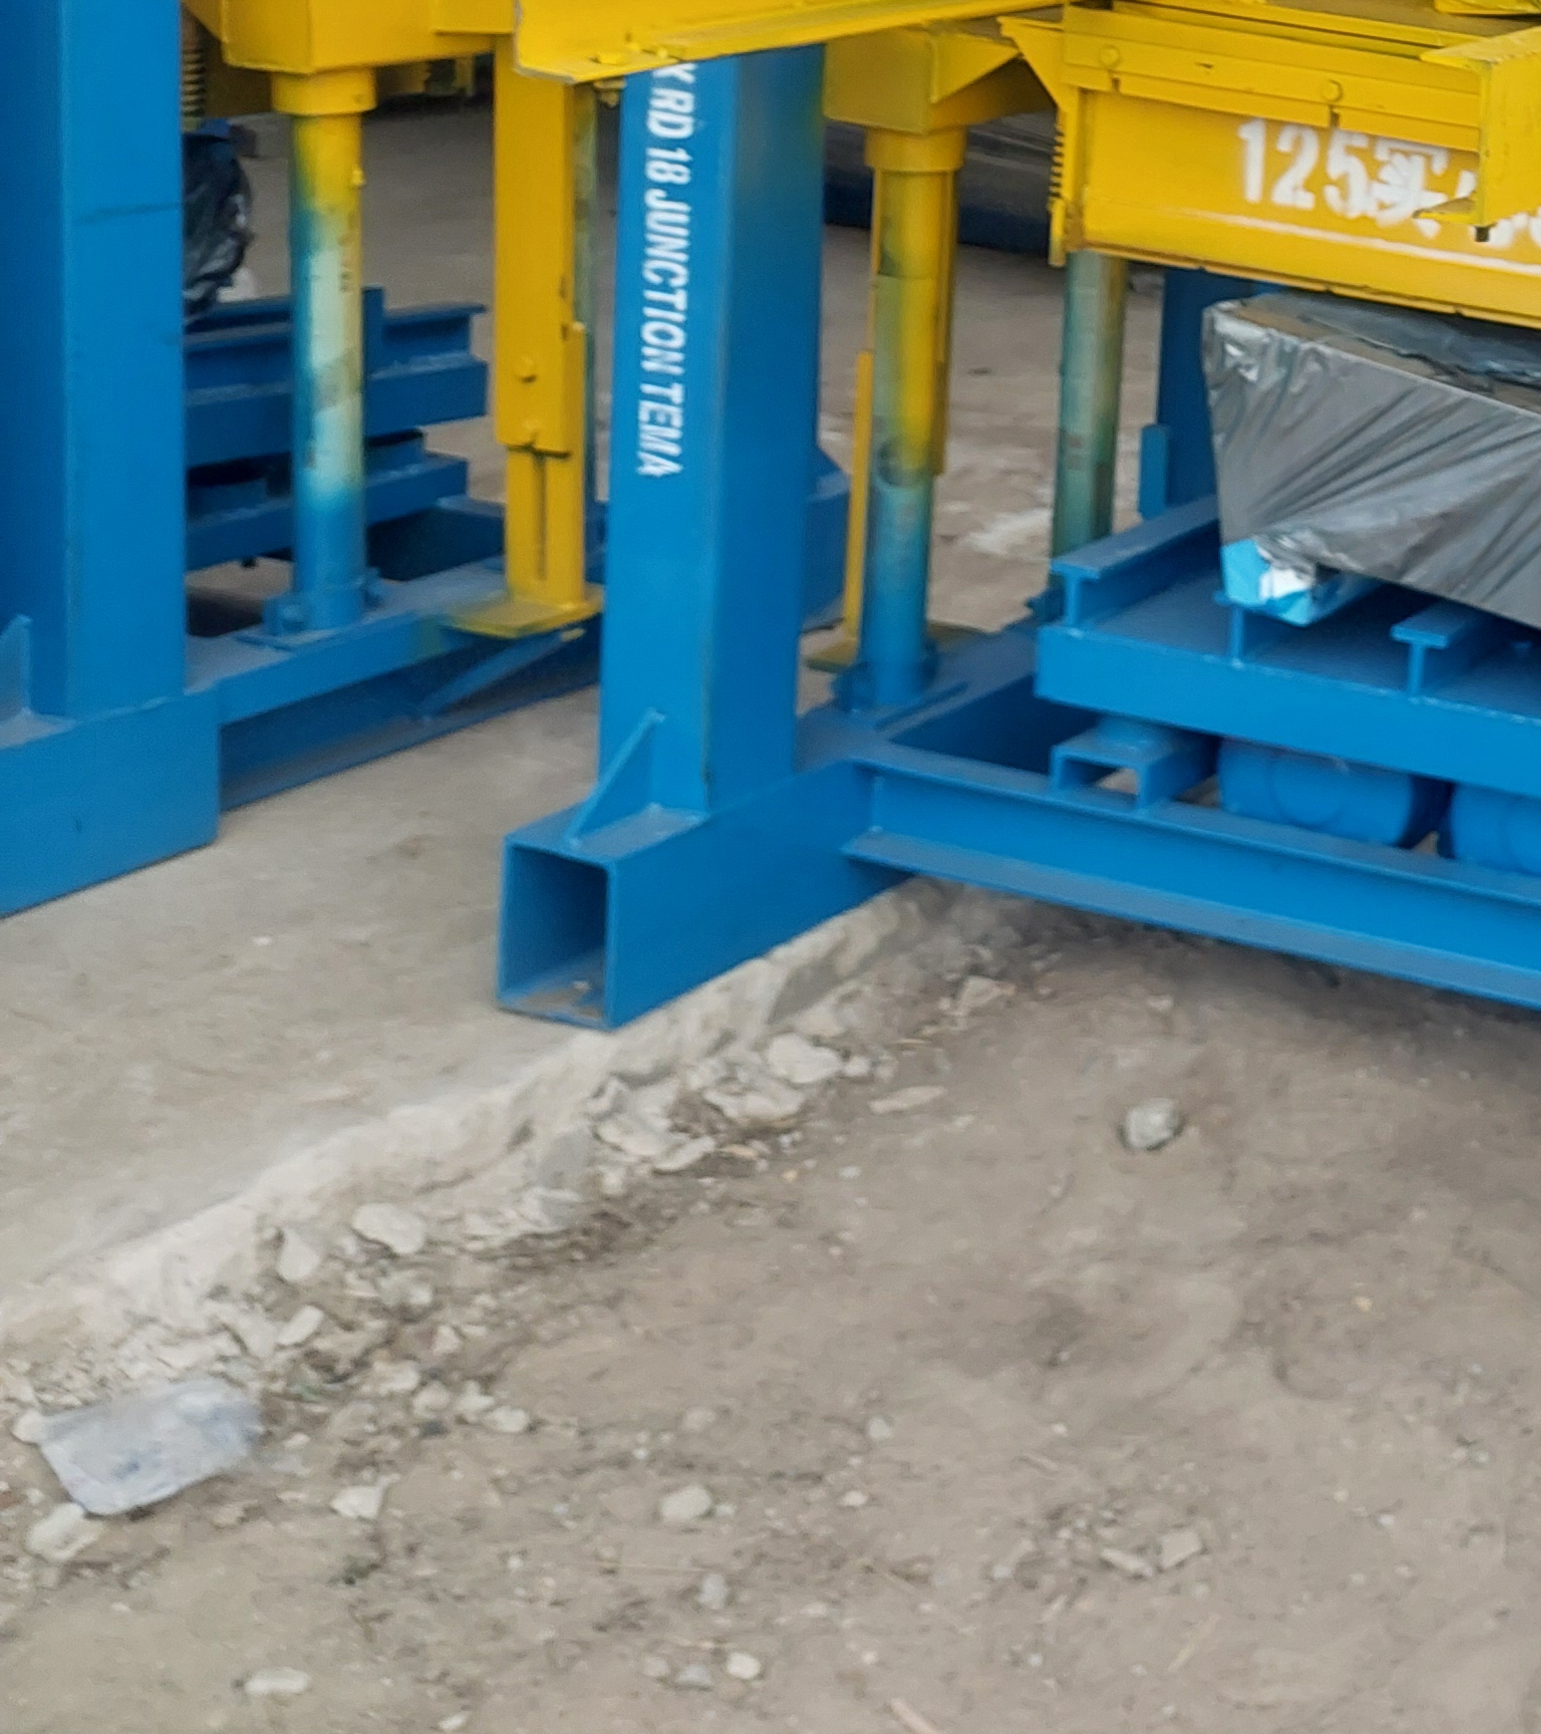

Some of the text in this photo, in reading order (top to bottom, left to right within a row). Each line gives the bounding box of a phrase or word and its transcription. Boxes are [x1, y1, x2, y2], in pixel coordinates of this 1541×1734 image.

[646, 87, 696, 140] RD
[645, 147, 694, 185] 18
[641, 188, 693, 376] JUNCTION
[637, 382, 685, 477] TEMA
